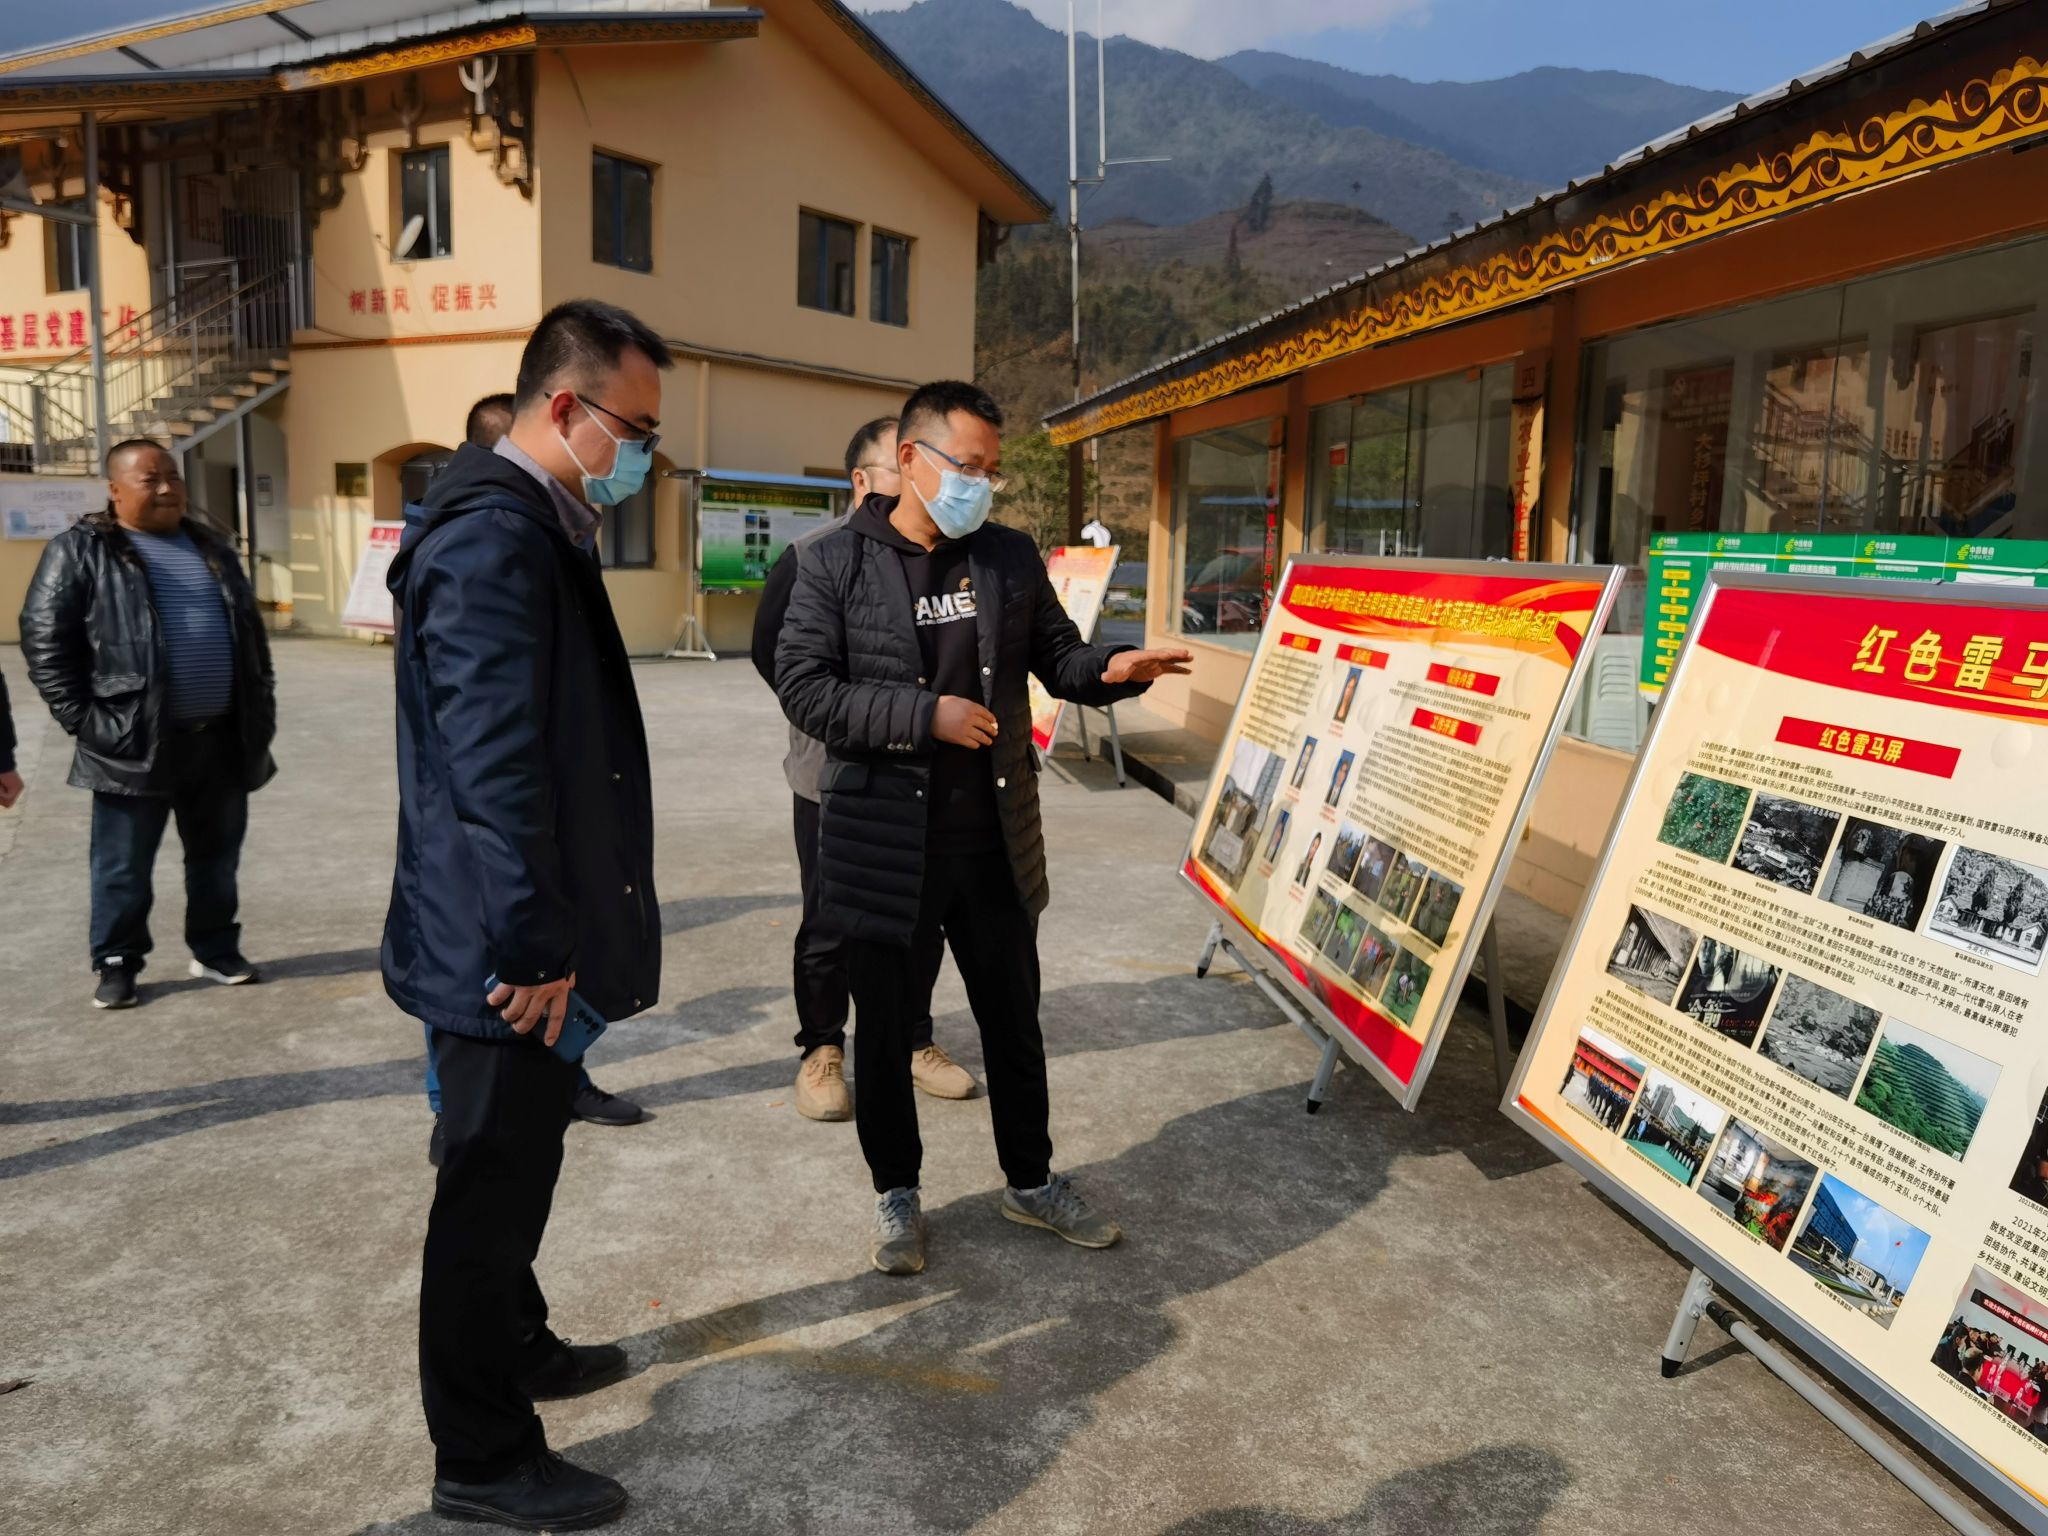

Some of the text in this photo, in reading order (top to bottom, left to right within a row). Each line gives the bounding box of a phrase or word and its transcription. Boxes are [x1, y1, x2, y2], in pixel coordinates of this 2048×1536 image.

[432, 283, 497, 312] 促振兴
[1818, 726, 1905, 764] 红色雷马屏
[1988, 1220, 2048, 1265] 脱贫攻坚成果同
[1976, 1251, 2048, 1302] 乡村治理、建设文明
